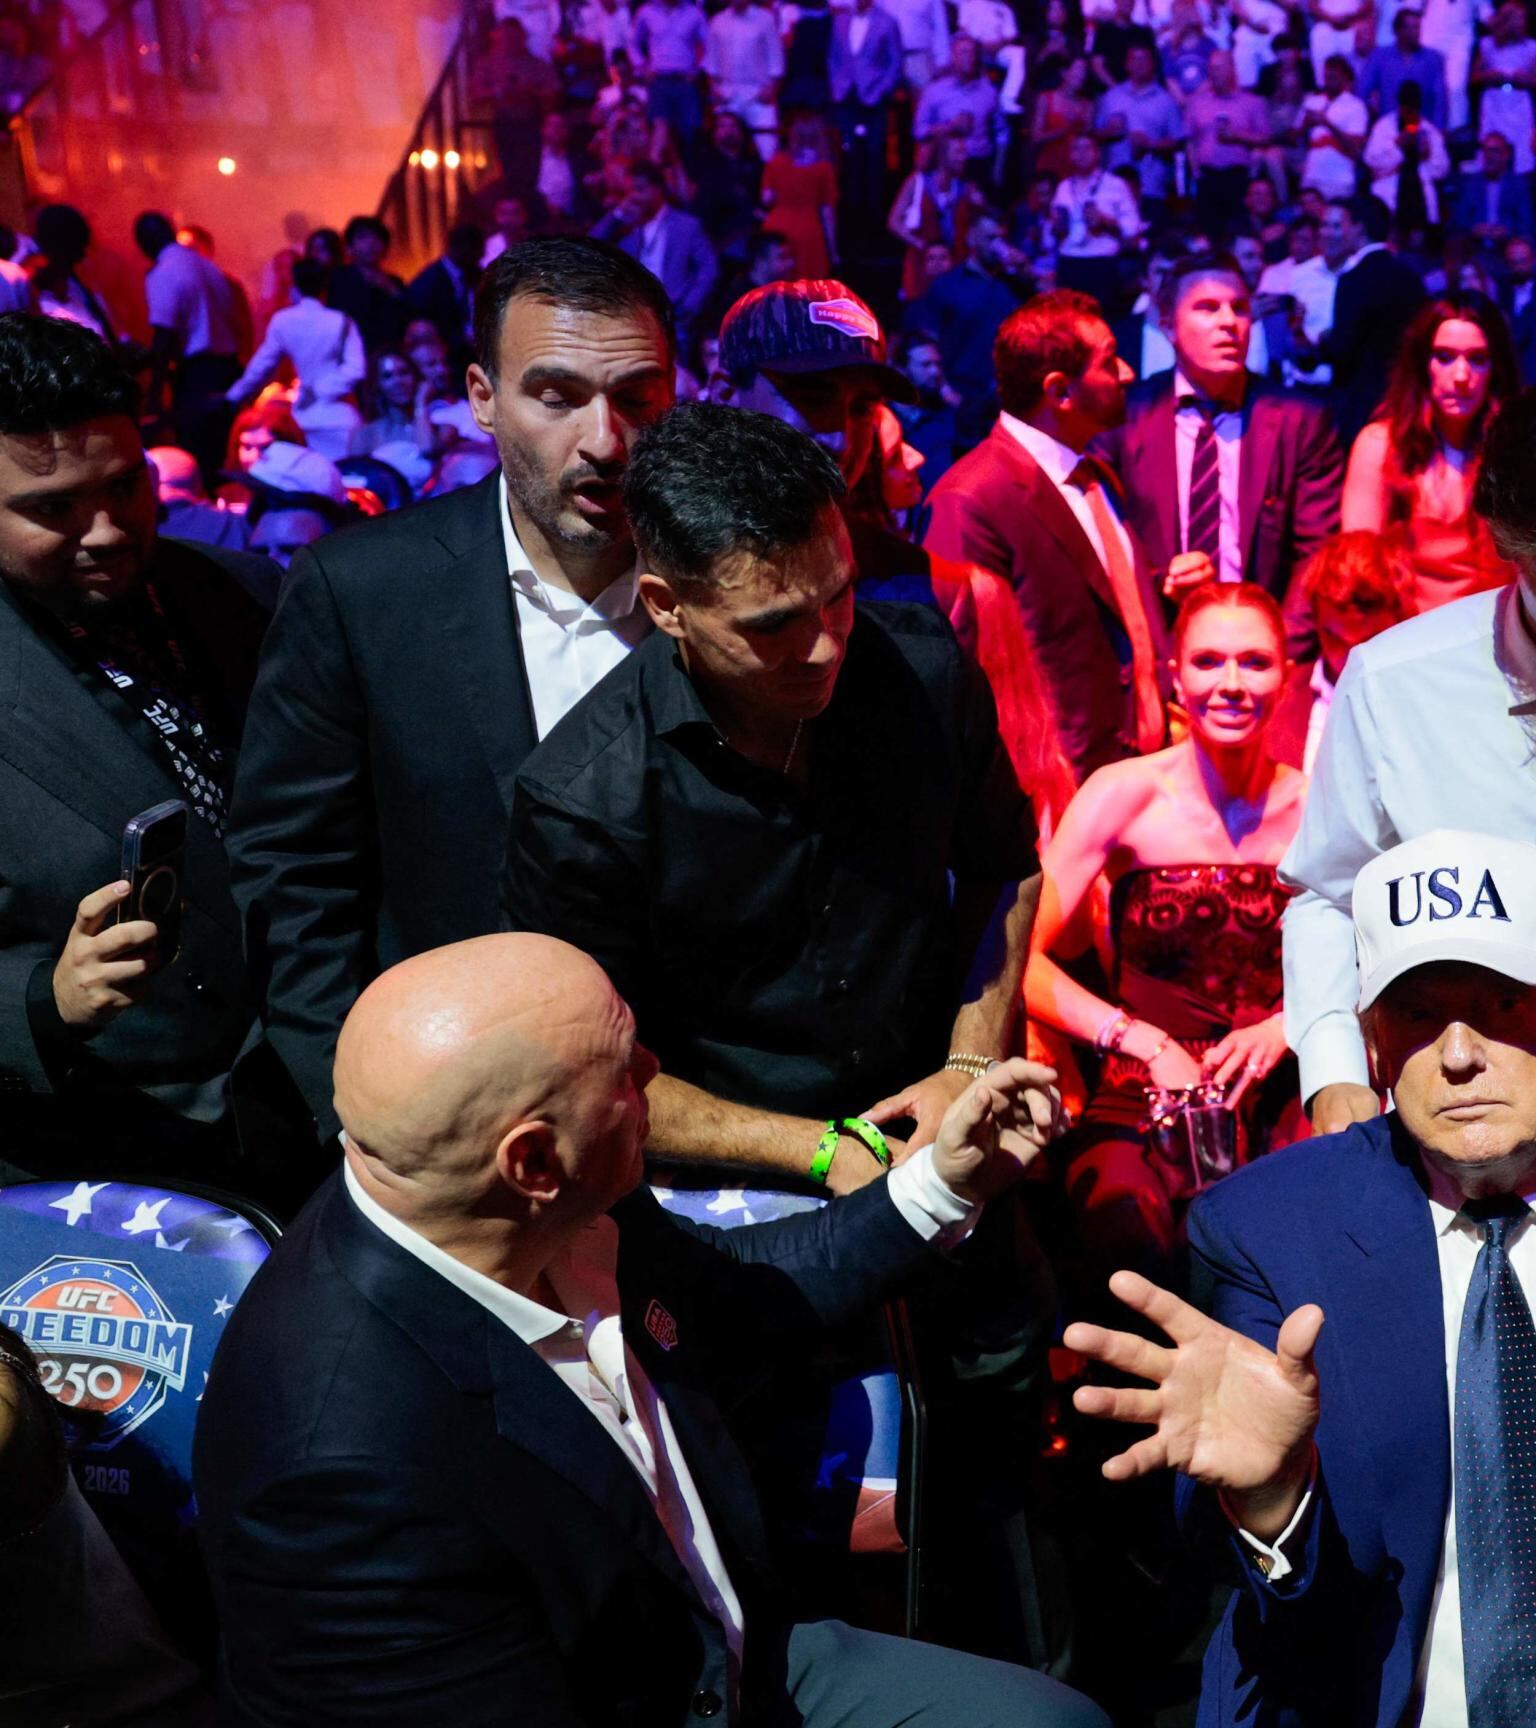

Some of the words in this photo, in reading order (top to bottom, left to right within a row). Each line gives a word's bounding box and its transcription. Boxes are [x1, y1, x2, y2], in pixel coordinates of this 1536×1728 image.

[143, 704, 179, 735] UFC
[1386, 867, 1512, 927] USA
[58, 1286, 118, 1311] UFC
[0, 1309, 188, 1376] REEDOM
[40, 1360, 122, 1407] 250
[84, 1465, 130, 1496] 2026
